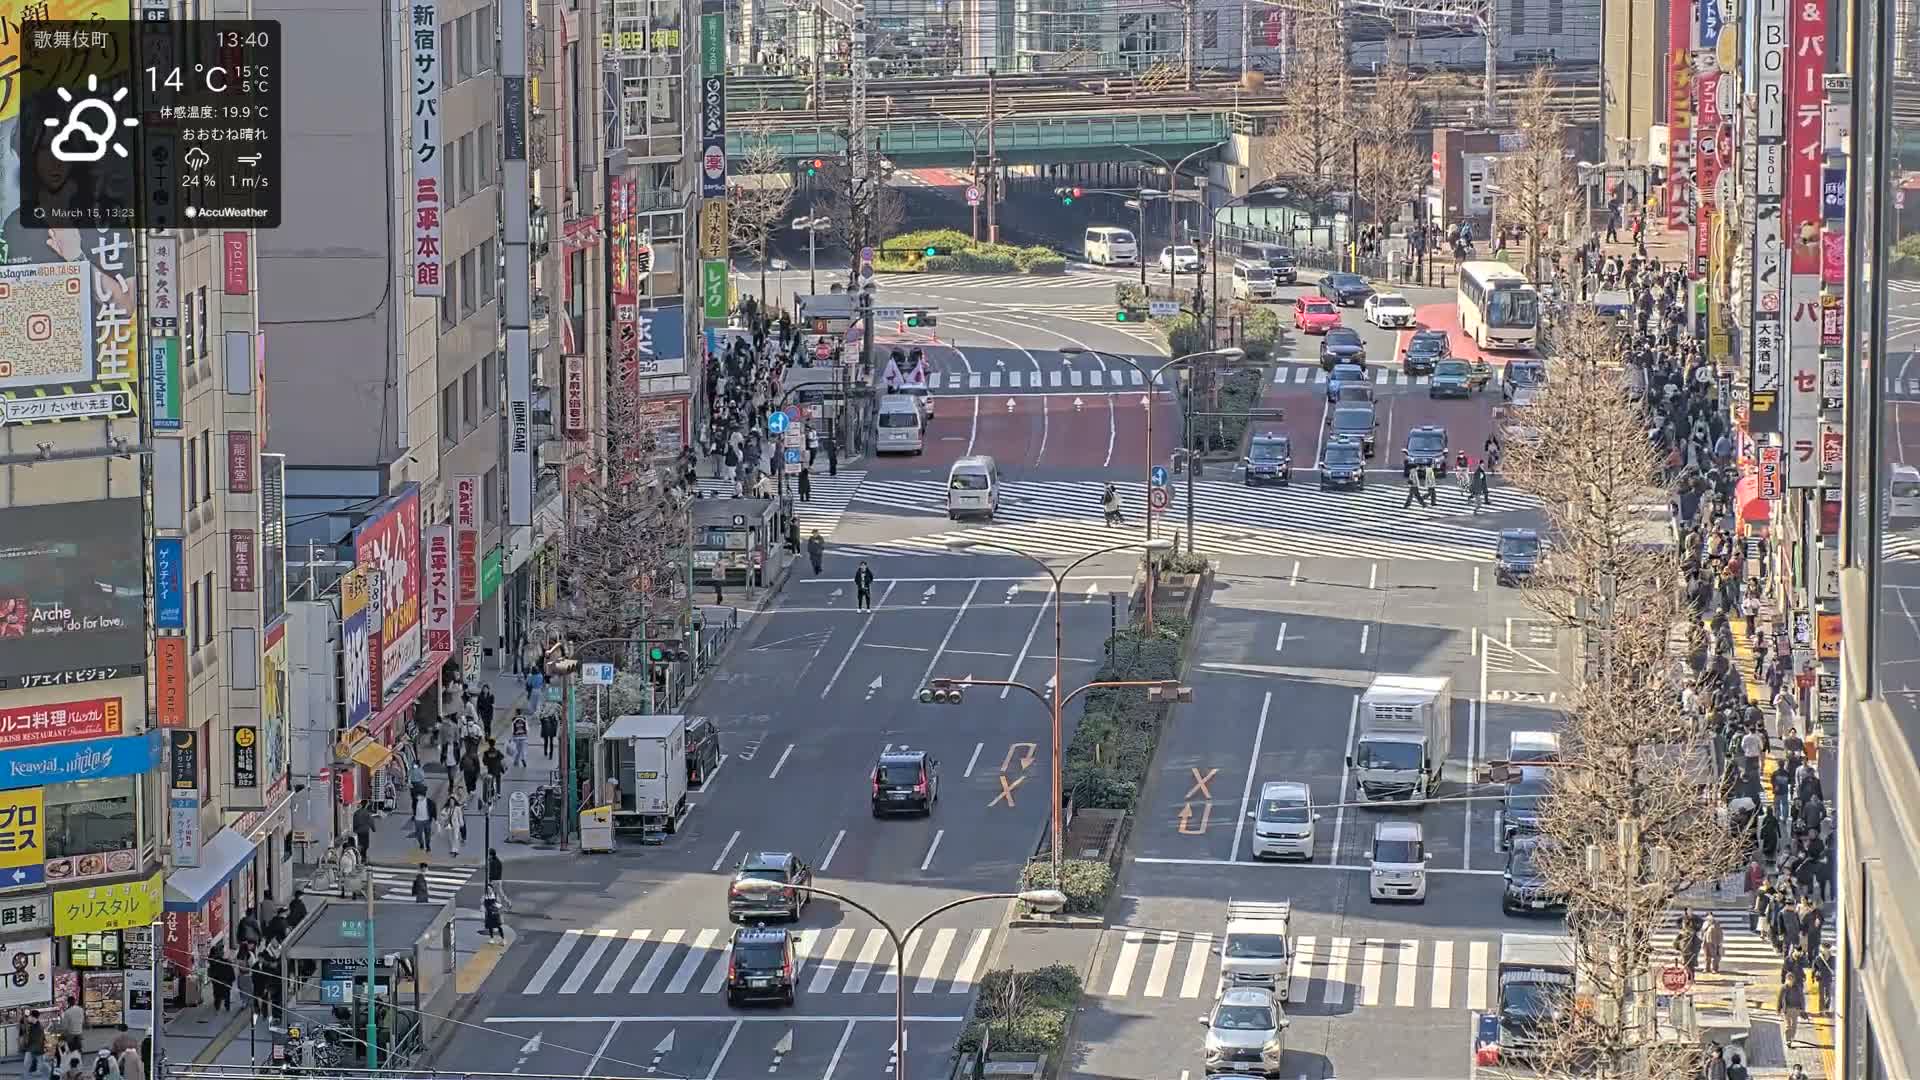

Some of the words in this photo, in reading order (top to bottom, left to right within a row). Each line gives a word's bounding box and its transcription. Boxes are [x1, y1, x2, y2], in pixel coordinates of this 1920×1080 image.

[148, 11, 165, 21] 6F
[414, 4, 437, 163] 新宿サンパーク
[1703, 80, 1716, 113] アコム
[1767, 145, 1775, 193] ESOLA
[416, 177, 440, 286] 三平本館
[708, 269, 721, 307] レイク
[155, 318, 173, 327] 3F
[1758, 323, 1771, 375] 大衆酒場
[154, 347, 168, 408] FamilyMart
[1794, 303, 1819, 463] パセラ
[10, 403, 46, 415] テンクリ
[51, 397, 110, 412] たいせい先生
[459, 480, 470, 525] GAME
[431, 536, 448, 623] 三平ストア
[371, 573, 379, 613] 389
[32, 602, 71, 621] Arche
[83, 616, 97, 629] for
[0, 709, 68, 733] ルコ料理
[68, 709, 102, 724] パムッカレ
[107, 705, 118, 729] 5F
[22, 729, 66, 741] RESTAURANT
[0, 805, 37, 826] プロ
[0, 832, 38, 851] ミス
[2, 905, 37, 925] 囲碁
[67, 897, 140, 921] クリスタル
[327, 985, 340, 998] 12
